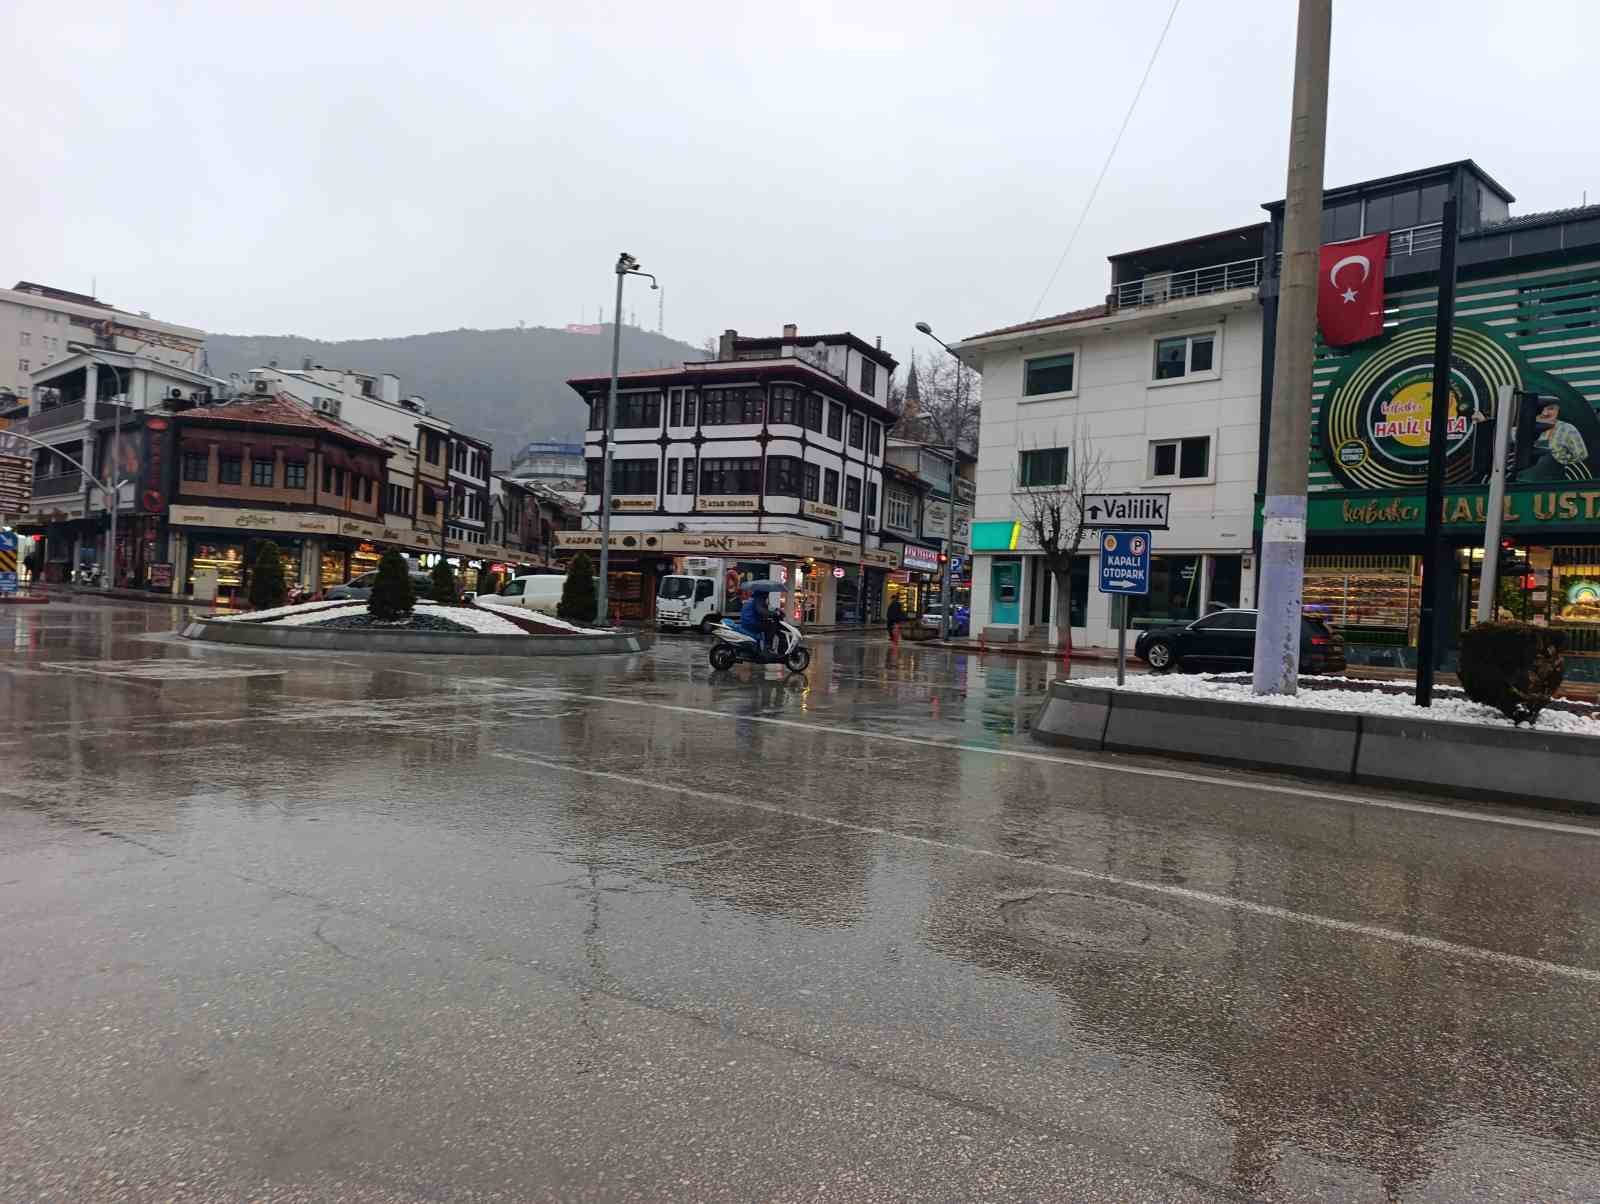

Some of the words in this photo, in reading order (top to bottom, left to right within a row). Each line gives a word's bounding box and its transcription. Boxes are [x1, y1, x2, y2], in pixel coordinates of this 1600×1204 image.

[1375, 416, 1420, 437] HALİL
[1103, 499, 1164, 519] Valilik
[1534, 489, 1600, 520] UST
[1134, 538, 1142, 550] P
[1107, 555, 1141, 567] KAPALI
[1103, 567, 1145, 580] OTOPARK
